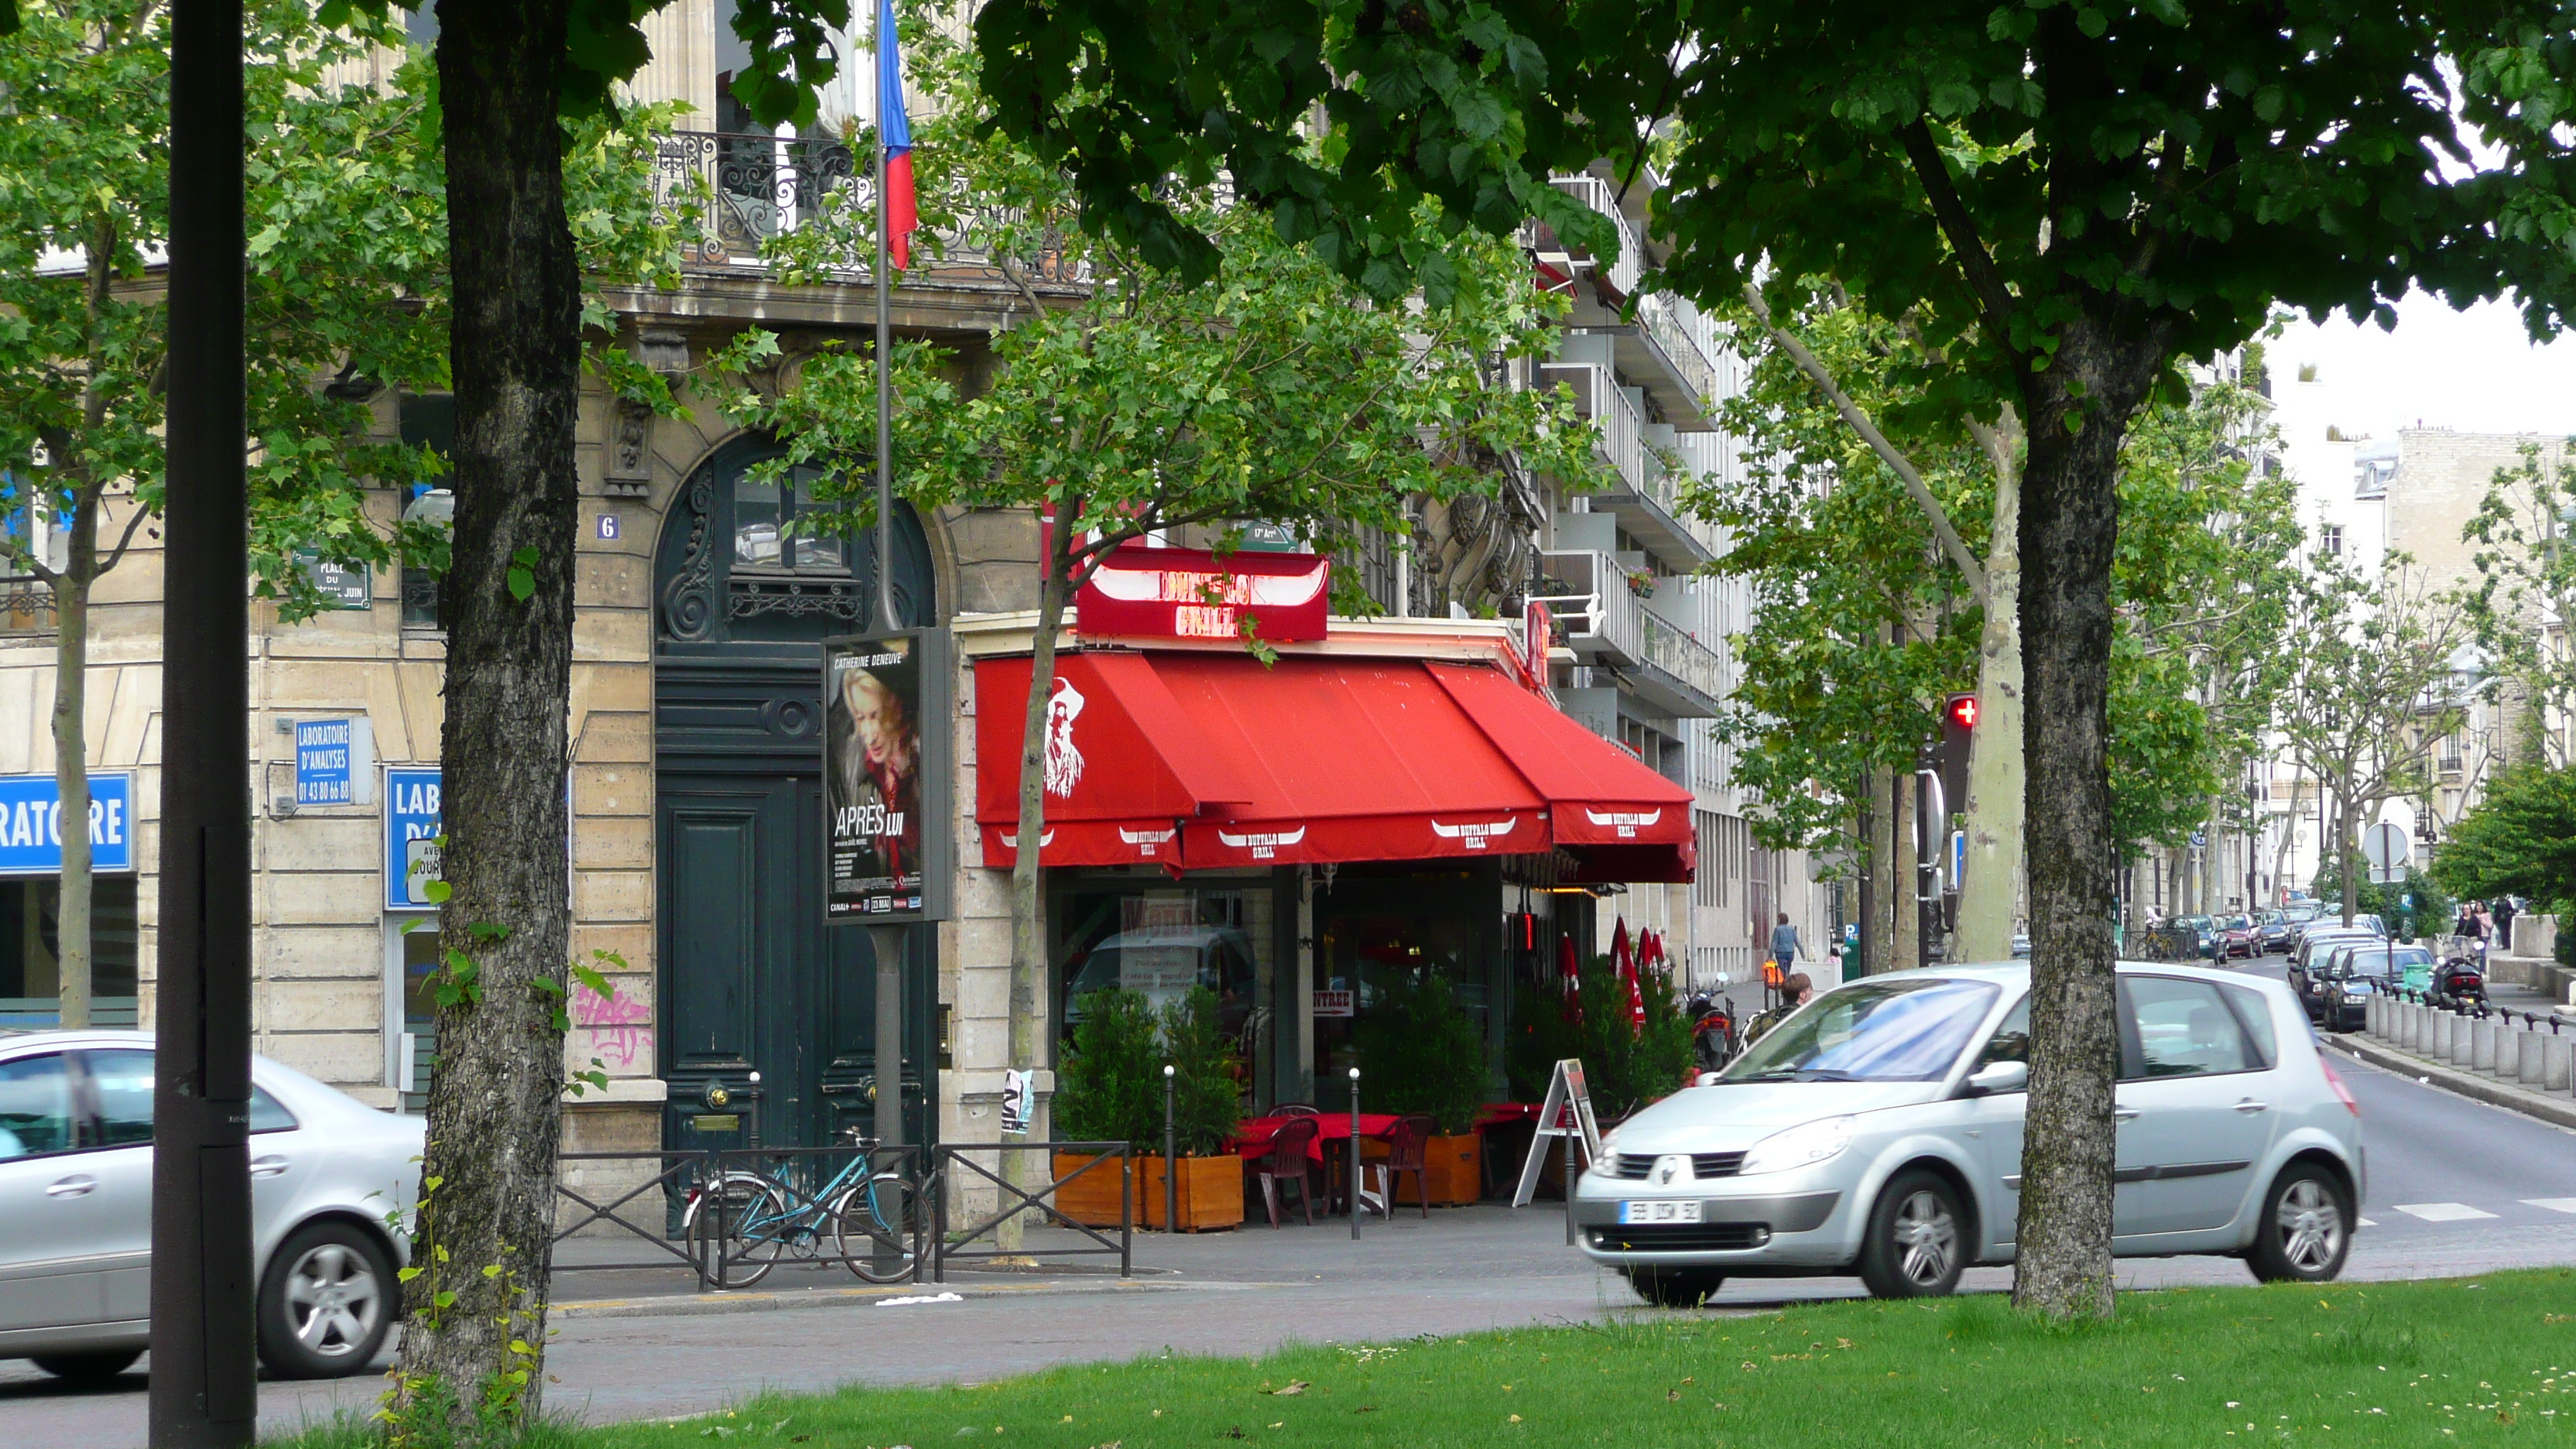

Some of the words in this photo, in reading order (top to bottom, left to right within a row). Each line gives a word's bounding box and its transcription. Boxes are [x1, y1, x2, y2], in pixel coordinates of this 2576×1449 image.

[602, 517, 614, 537] 6
[344, 587, 362, 598] JUIN
[1176, 605, 1238, 636] GRILL
[834, 656, 869, 670] CATHERINE
[872, 653, 903, 666] DENEUVE
[298, 724, 348, 746] LABORATOIRE
[301, 749, 346, 770] D'ANALYSES
[299, 782, 307, 801] 01
[309, 782, 318, 801] 43
[319, 781, 329, 800] 80
[330, 780, 339, 800] 66
[340, 780, 350, 800] 88
[834, 796, 885, 837] APRÈS
[886, 812, 904, 837] LUI
[1460, 823, 1489, 837] BUFFALO
[1247, 833, 1278, 847] BUFFALO
[1465, 836, 1486, 849] GRILL
[1252, 845, 1275, 859] GRILL
[1845, 924, 1855, 937] P
[1314, 992, 1350, 1007] NTREE
